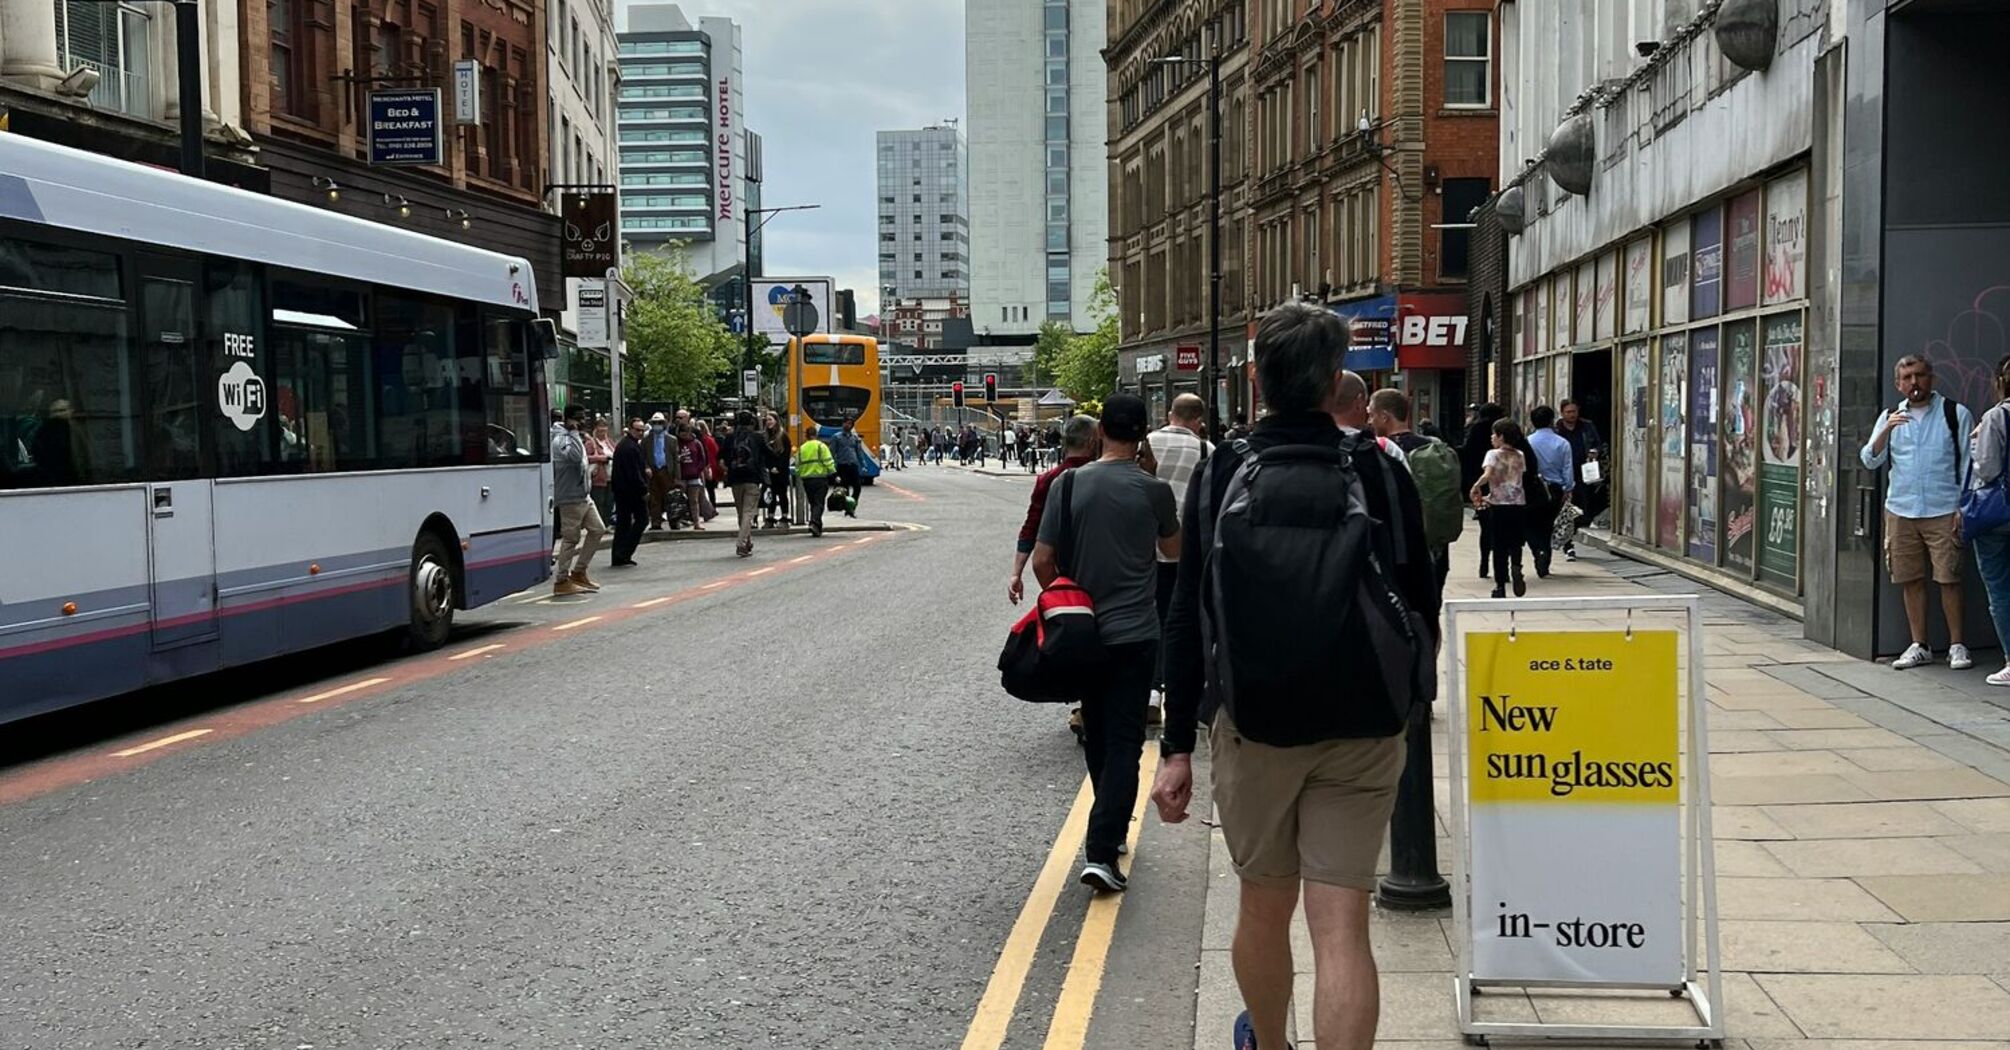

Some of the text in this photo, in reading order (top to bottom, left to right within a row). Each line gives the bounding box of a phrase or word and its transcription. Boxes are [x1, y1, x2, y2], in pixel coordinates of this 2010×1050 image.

[460, 71, 469, 117] HOTEL
[374, 121, 433, 130] BREAKFAST
[387, 107, 419, 117] BED &
[718, 77, 732, 221] mercure HOTEL
[224, 332, 254, 357] FREE
[1401, 315, 1469, 346] BET
[1529, 658, 1613, 671] ace & tate
[1478, 695, 1559, 732] New
[1487, 750, 1673, 796] sunglasses
[1497, 902, 1645, 949] in-store
